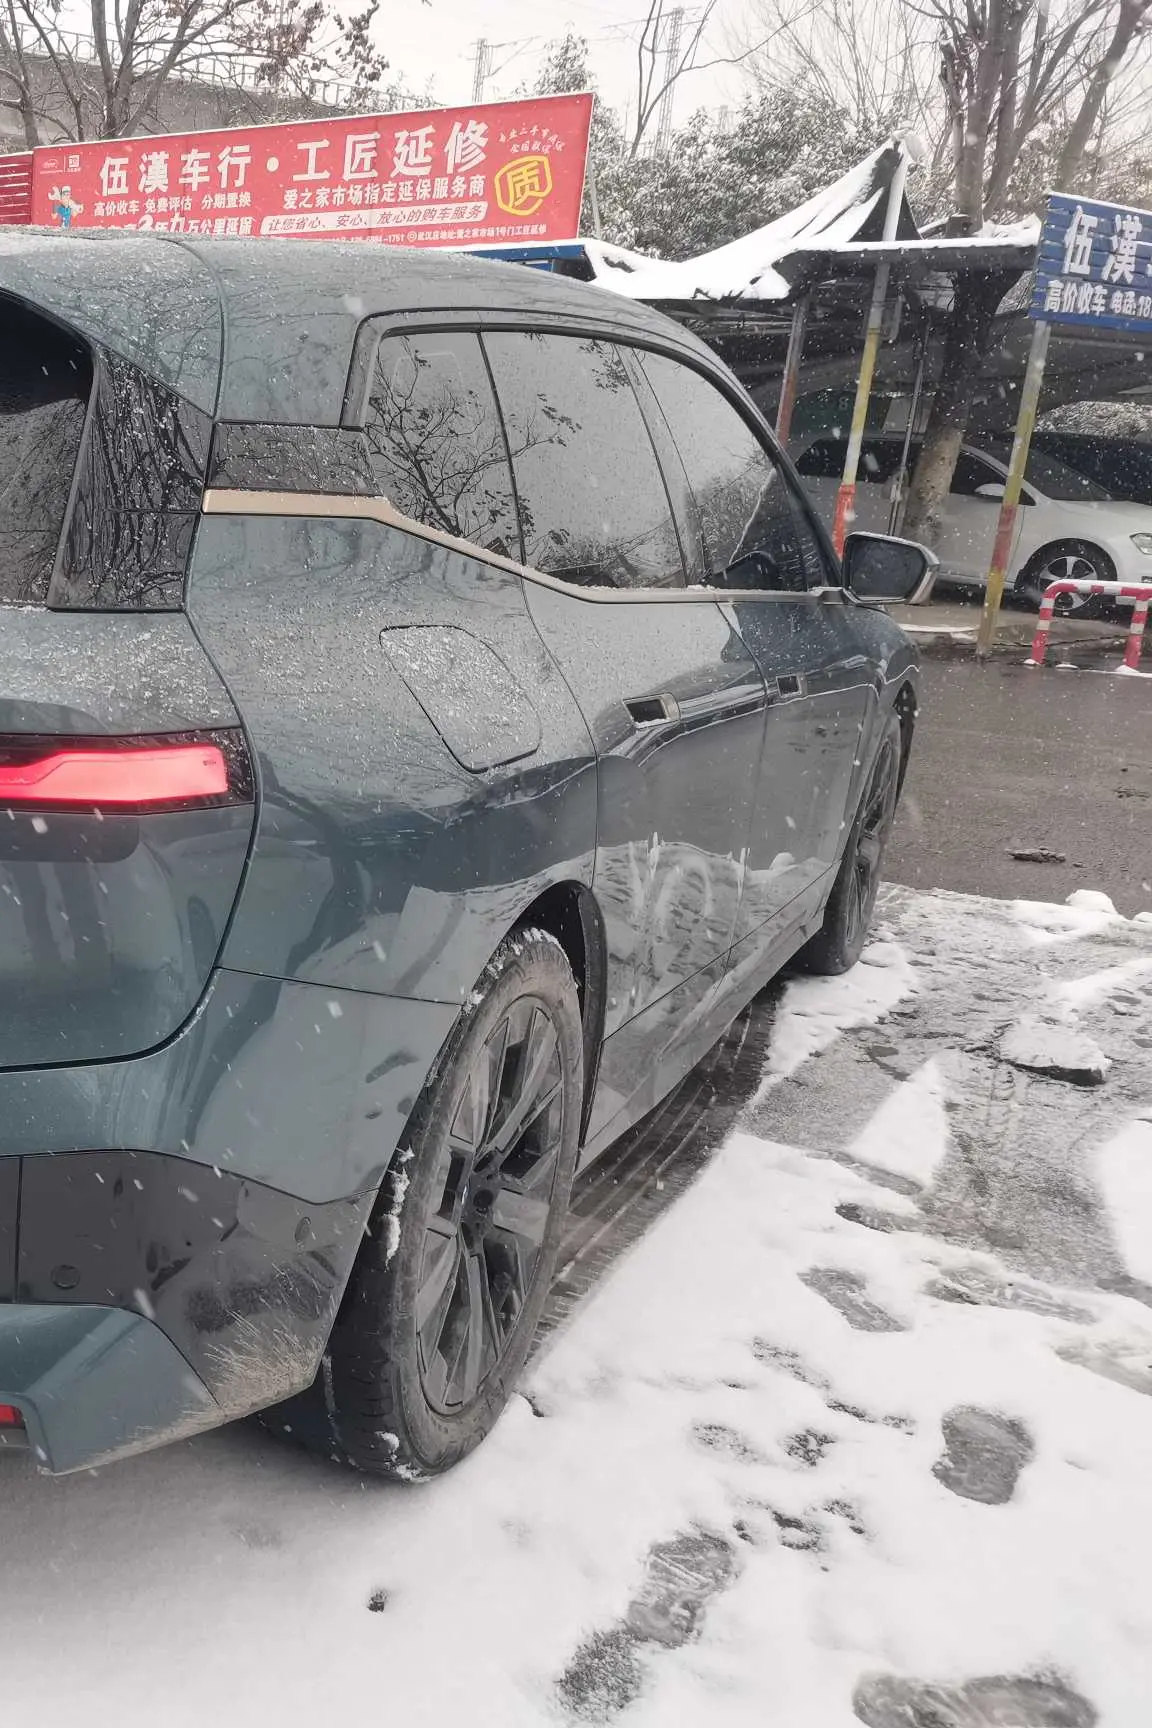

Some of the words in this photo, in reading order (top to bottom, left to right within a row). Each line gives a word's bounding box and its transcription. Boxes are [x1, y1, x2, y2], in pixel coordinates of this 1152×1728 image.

[94, 199, 140, 217] 高价收车
[144, 195, 193, 214] 免费评估
[201, 191, 252, 209] 分期置换
[283, 174, 486, 210] 爱之家市场指定延保服务商
[1062, 205, 1152, 284] 伍漢
[1044, 280, 1108, 316] 高价收车
